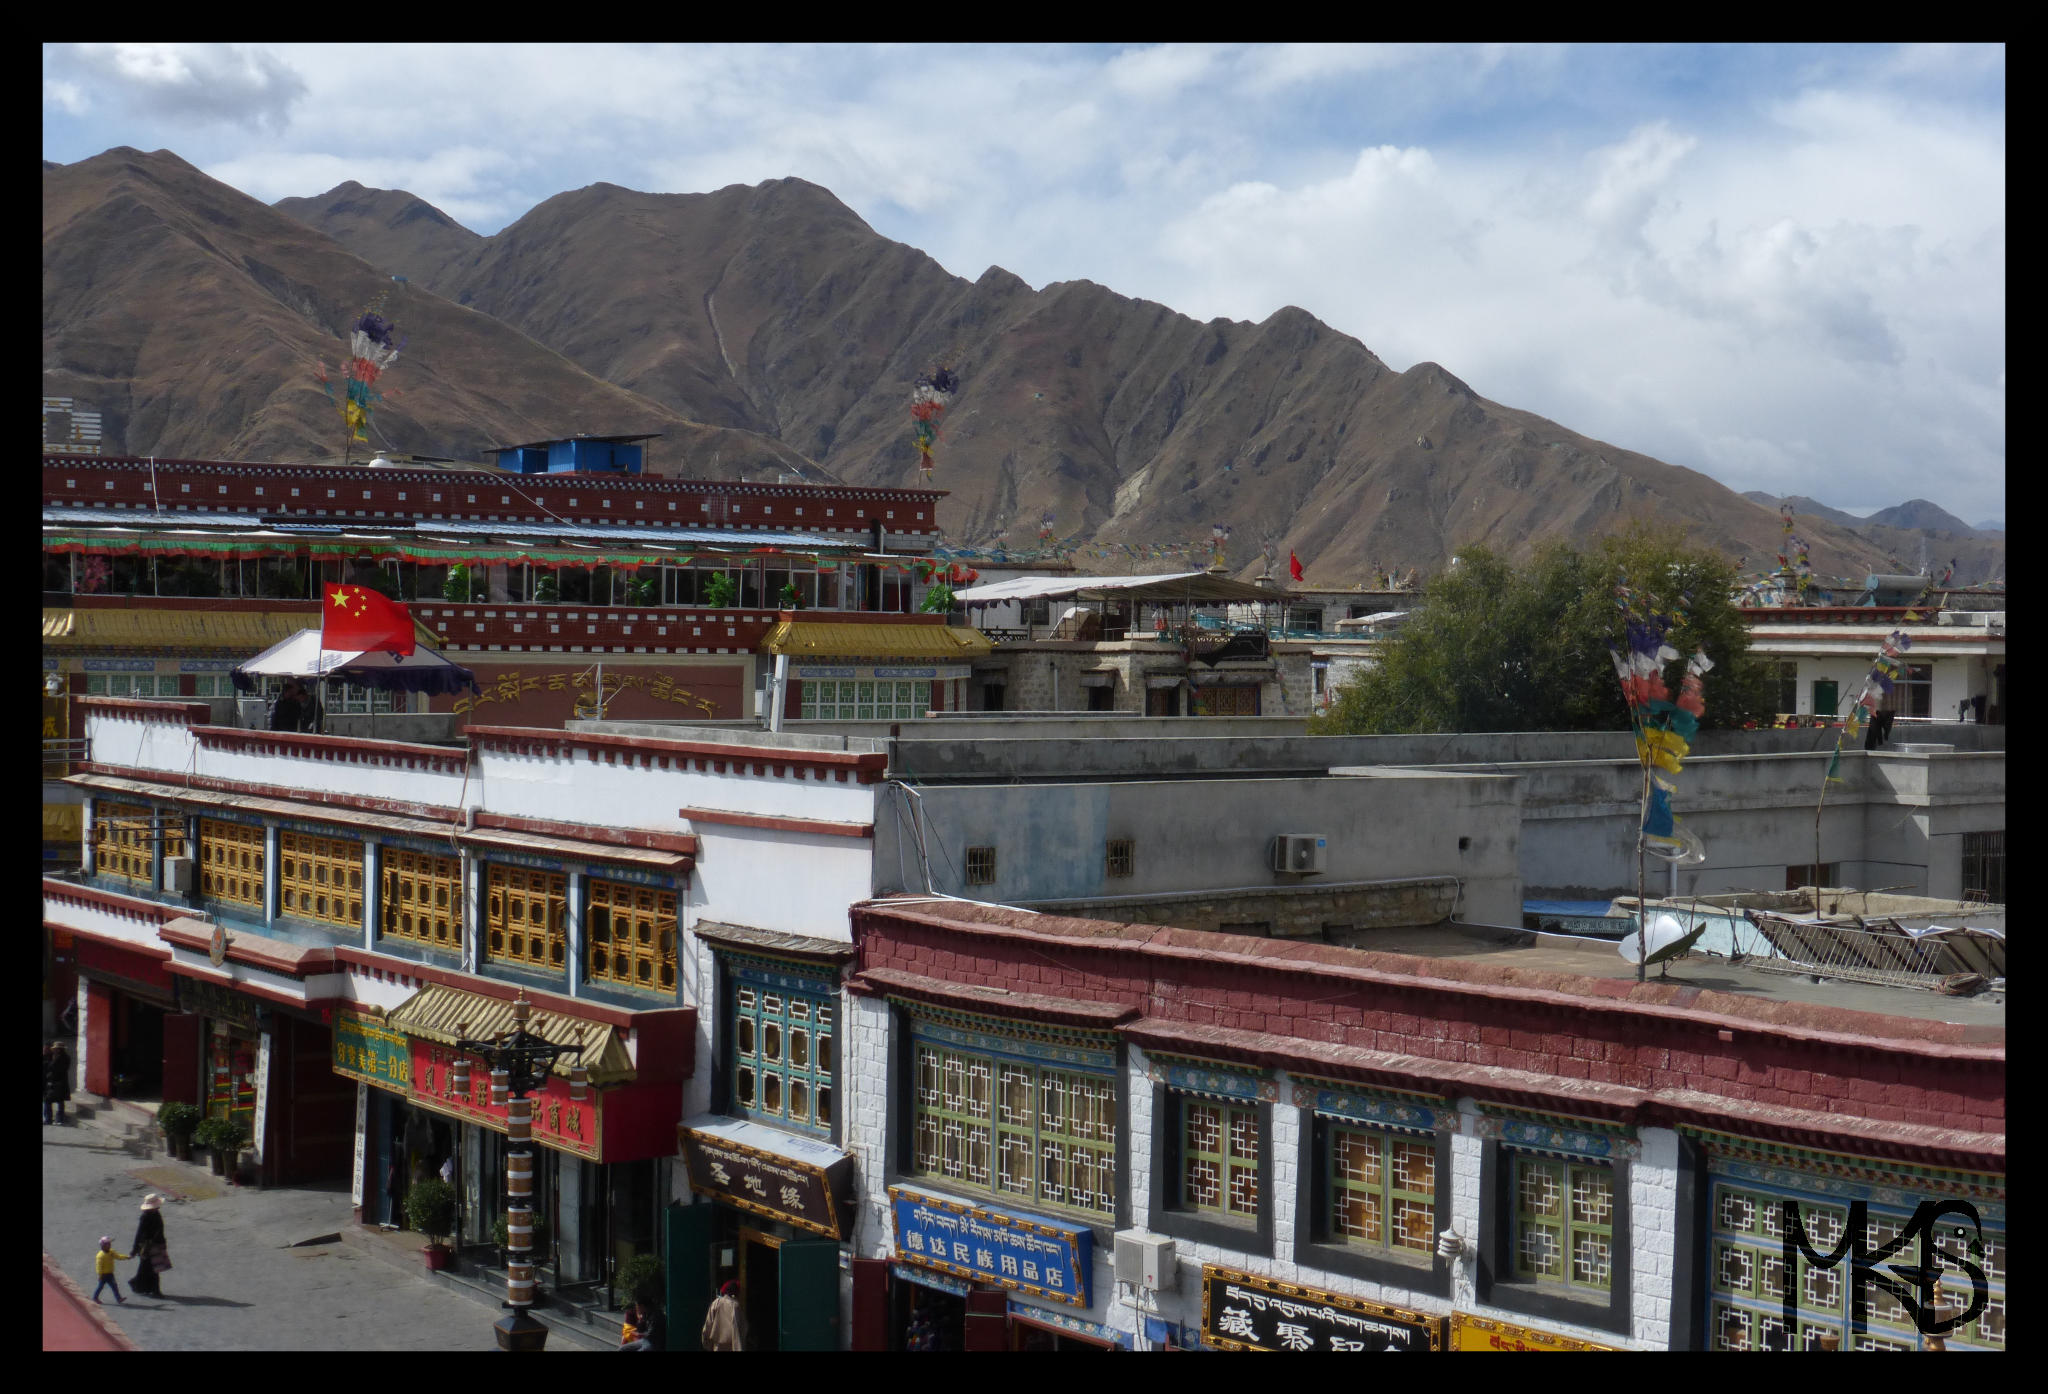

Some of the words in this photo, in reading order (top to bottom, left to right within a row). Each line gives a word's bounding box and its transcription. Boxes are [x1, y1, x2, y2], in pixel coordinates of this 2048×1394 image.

[710, 1162, 805, 1210] 圣地缘
[906, 1230, 1063, 1288] 德达民族用品店
[1219, 1307, 1402, 1351] 藏聚印
